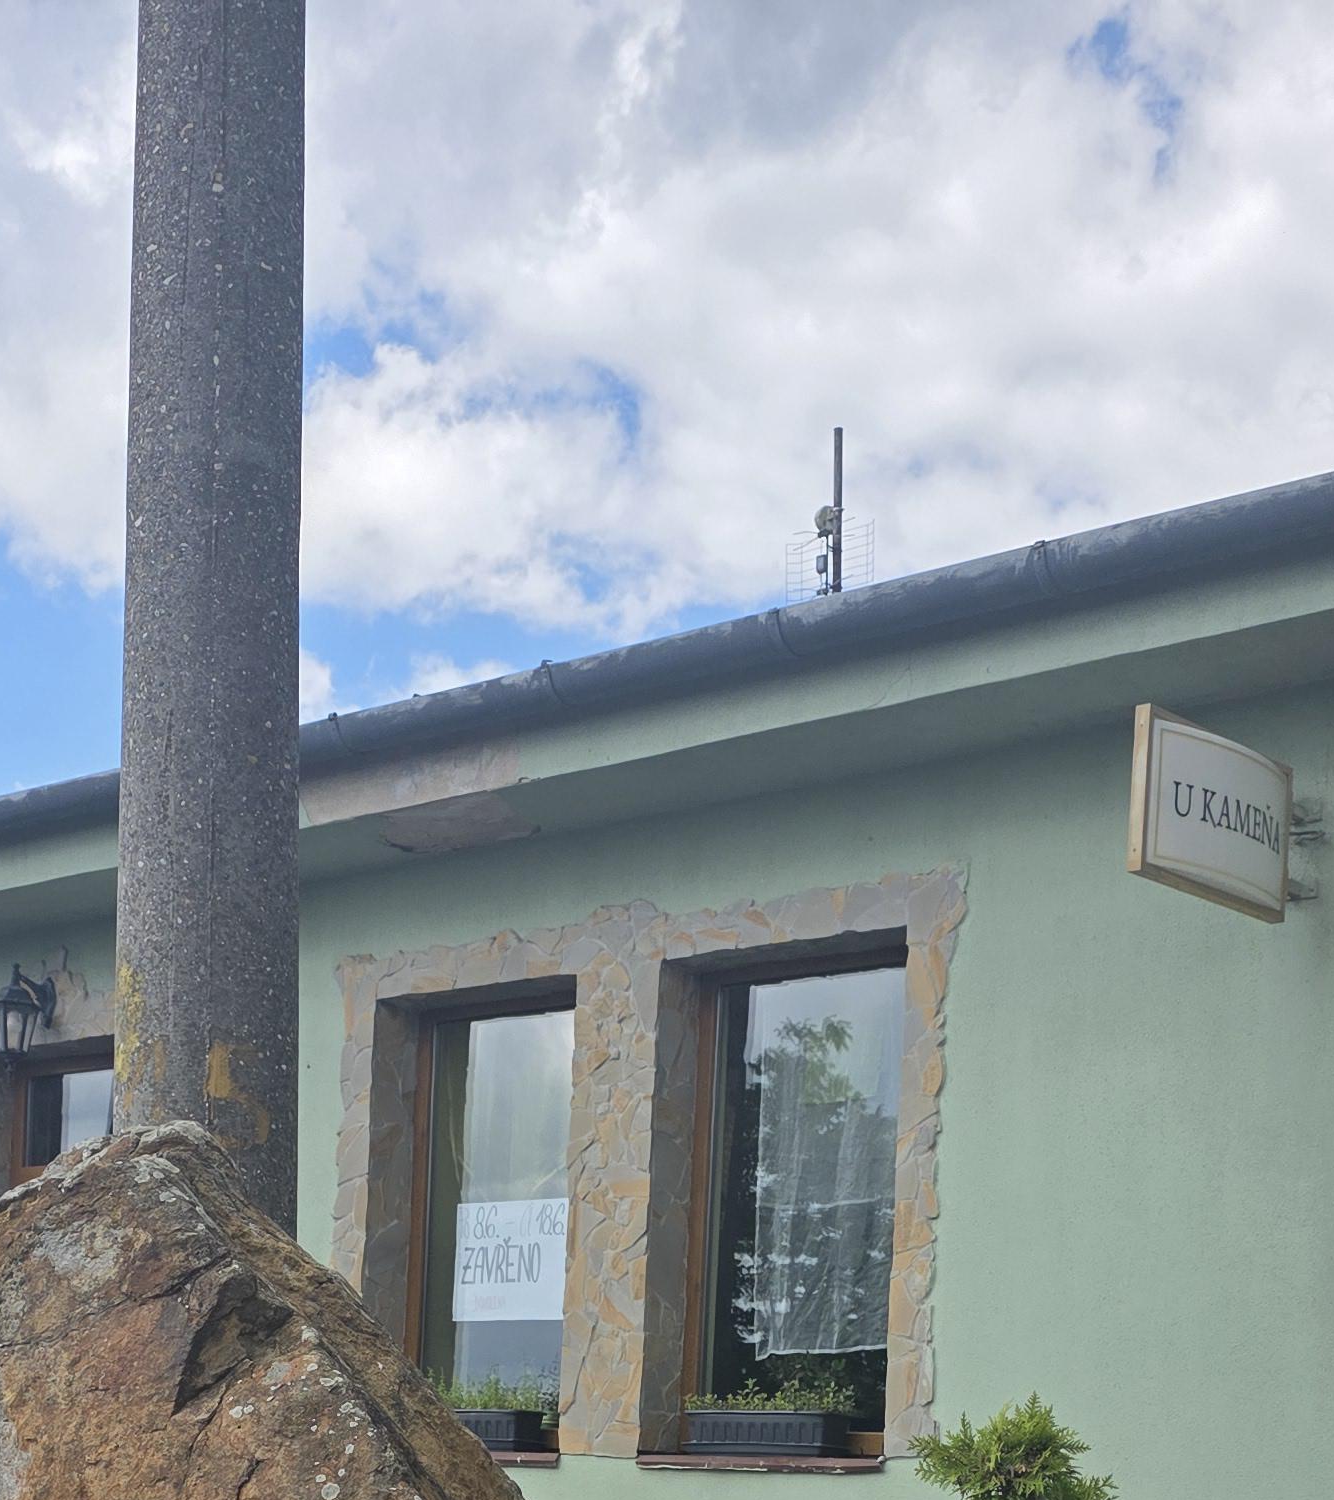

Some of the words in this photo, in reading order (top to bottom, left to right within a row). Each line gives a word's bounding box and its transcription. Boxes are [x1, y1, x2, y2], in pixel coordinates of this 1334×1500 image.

[1173, 780, 1194, 817] U
[1200, 787, 1280, 855] KAMEŇA
[461, 1236, 541, 1285] ZAVŘENO
